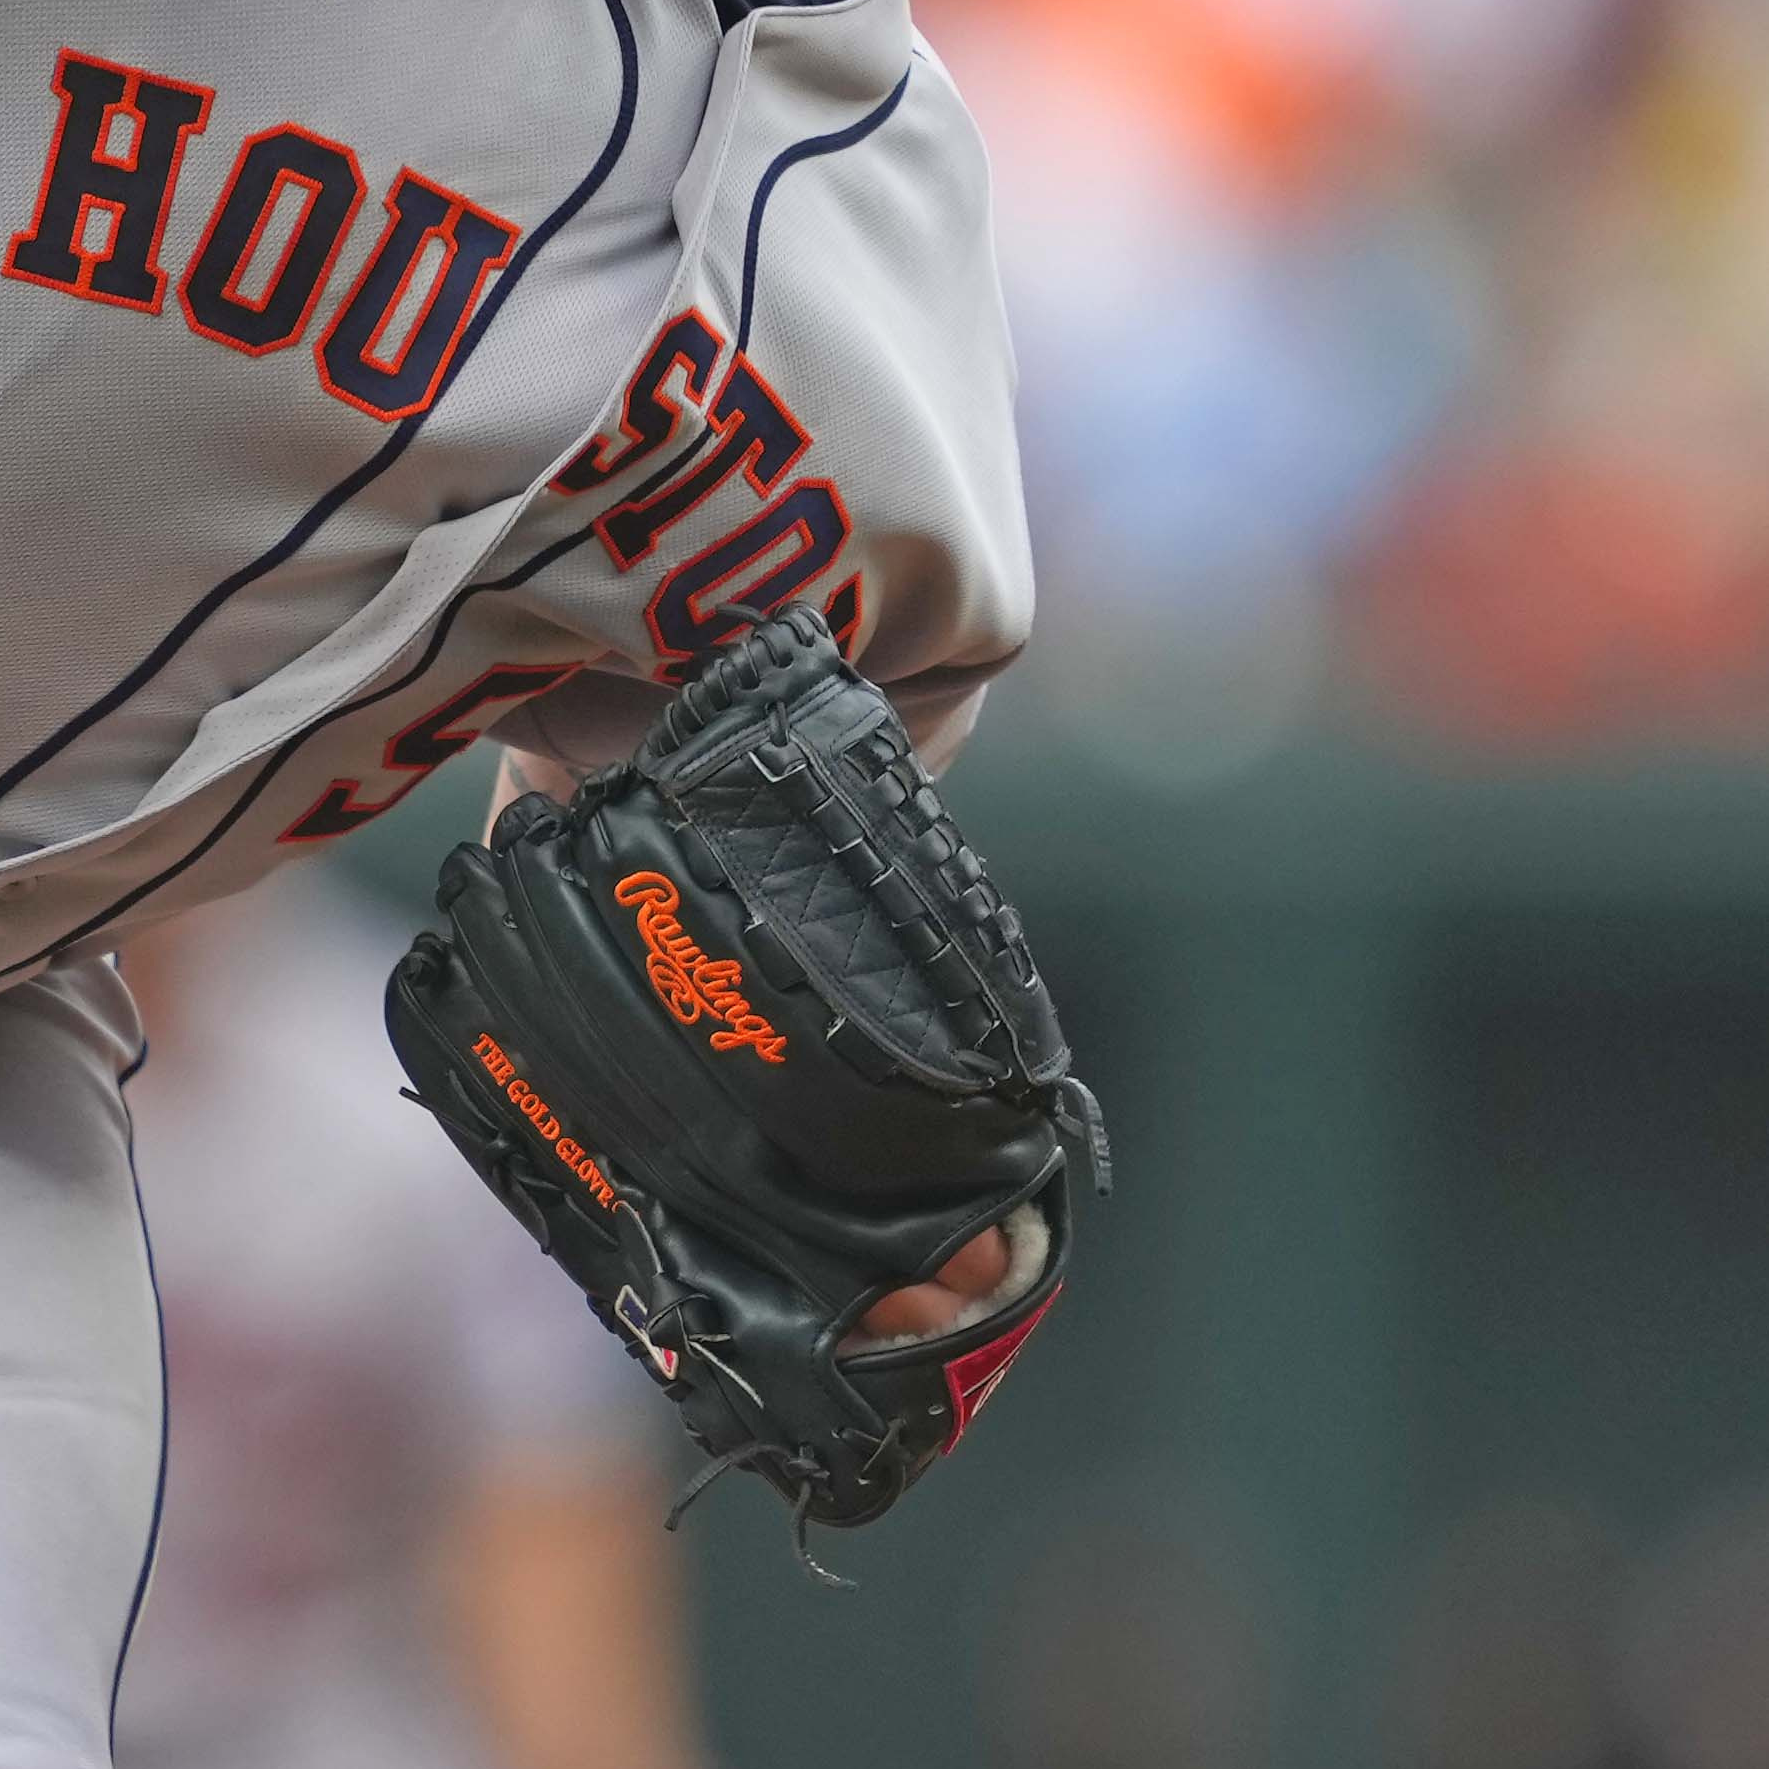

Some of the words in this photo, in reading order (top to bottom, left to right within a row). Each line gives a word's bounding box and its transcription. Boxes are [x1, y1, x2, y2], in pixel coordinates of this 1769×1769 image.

[547, 305, 864, 684] STO
[614, 870, 788, 1063] Rawlings
[471, 1032, 516, 1087] THE
[506, 1078, 561, 1141] GOLD
[555, 1137, 615, 1209] GLOVE
